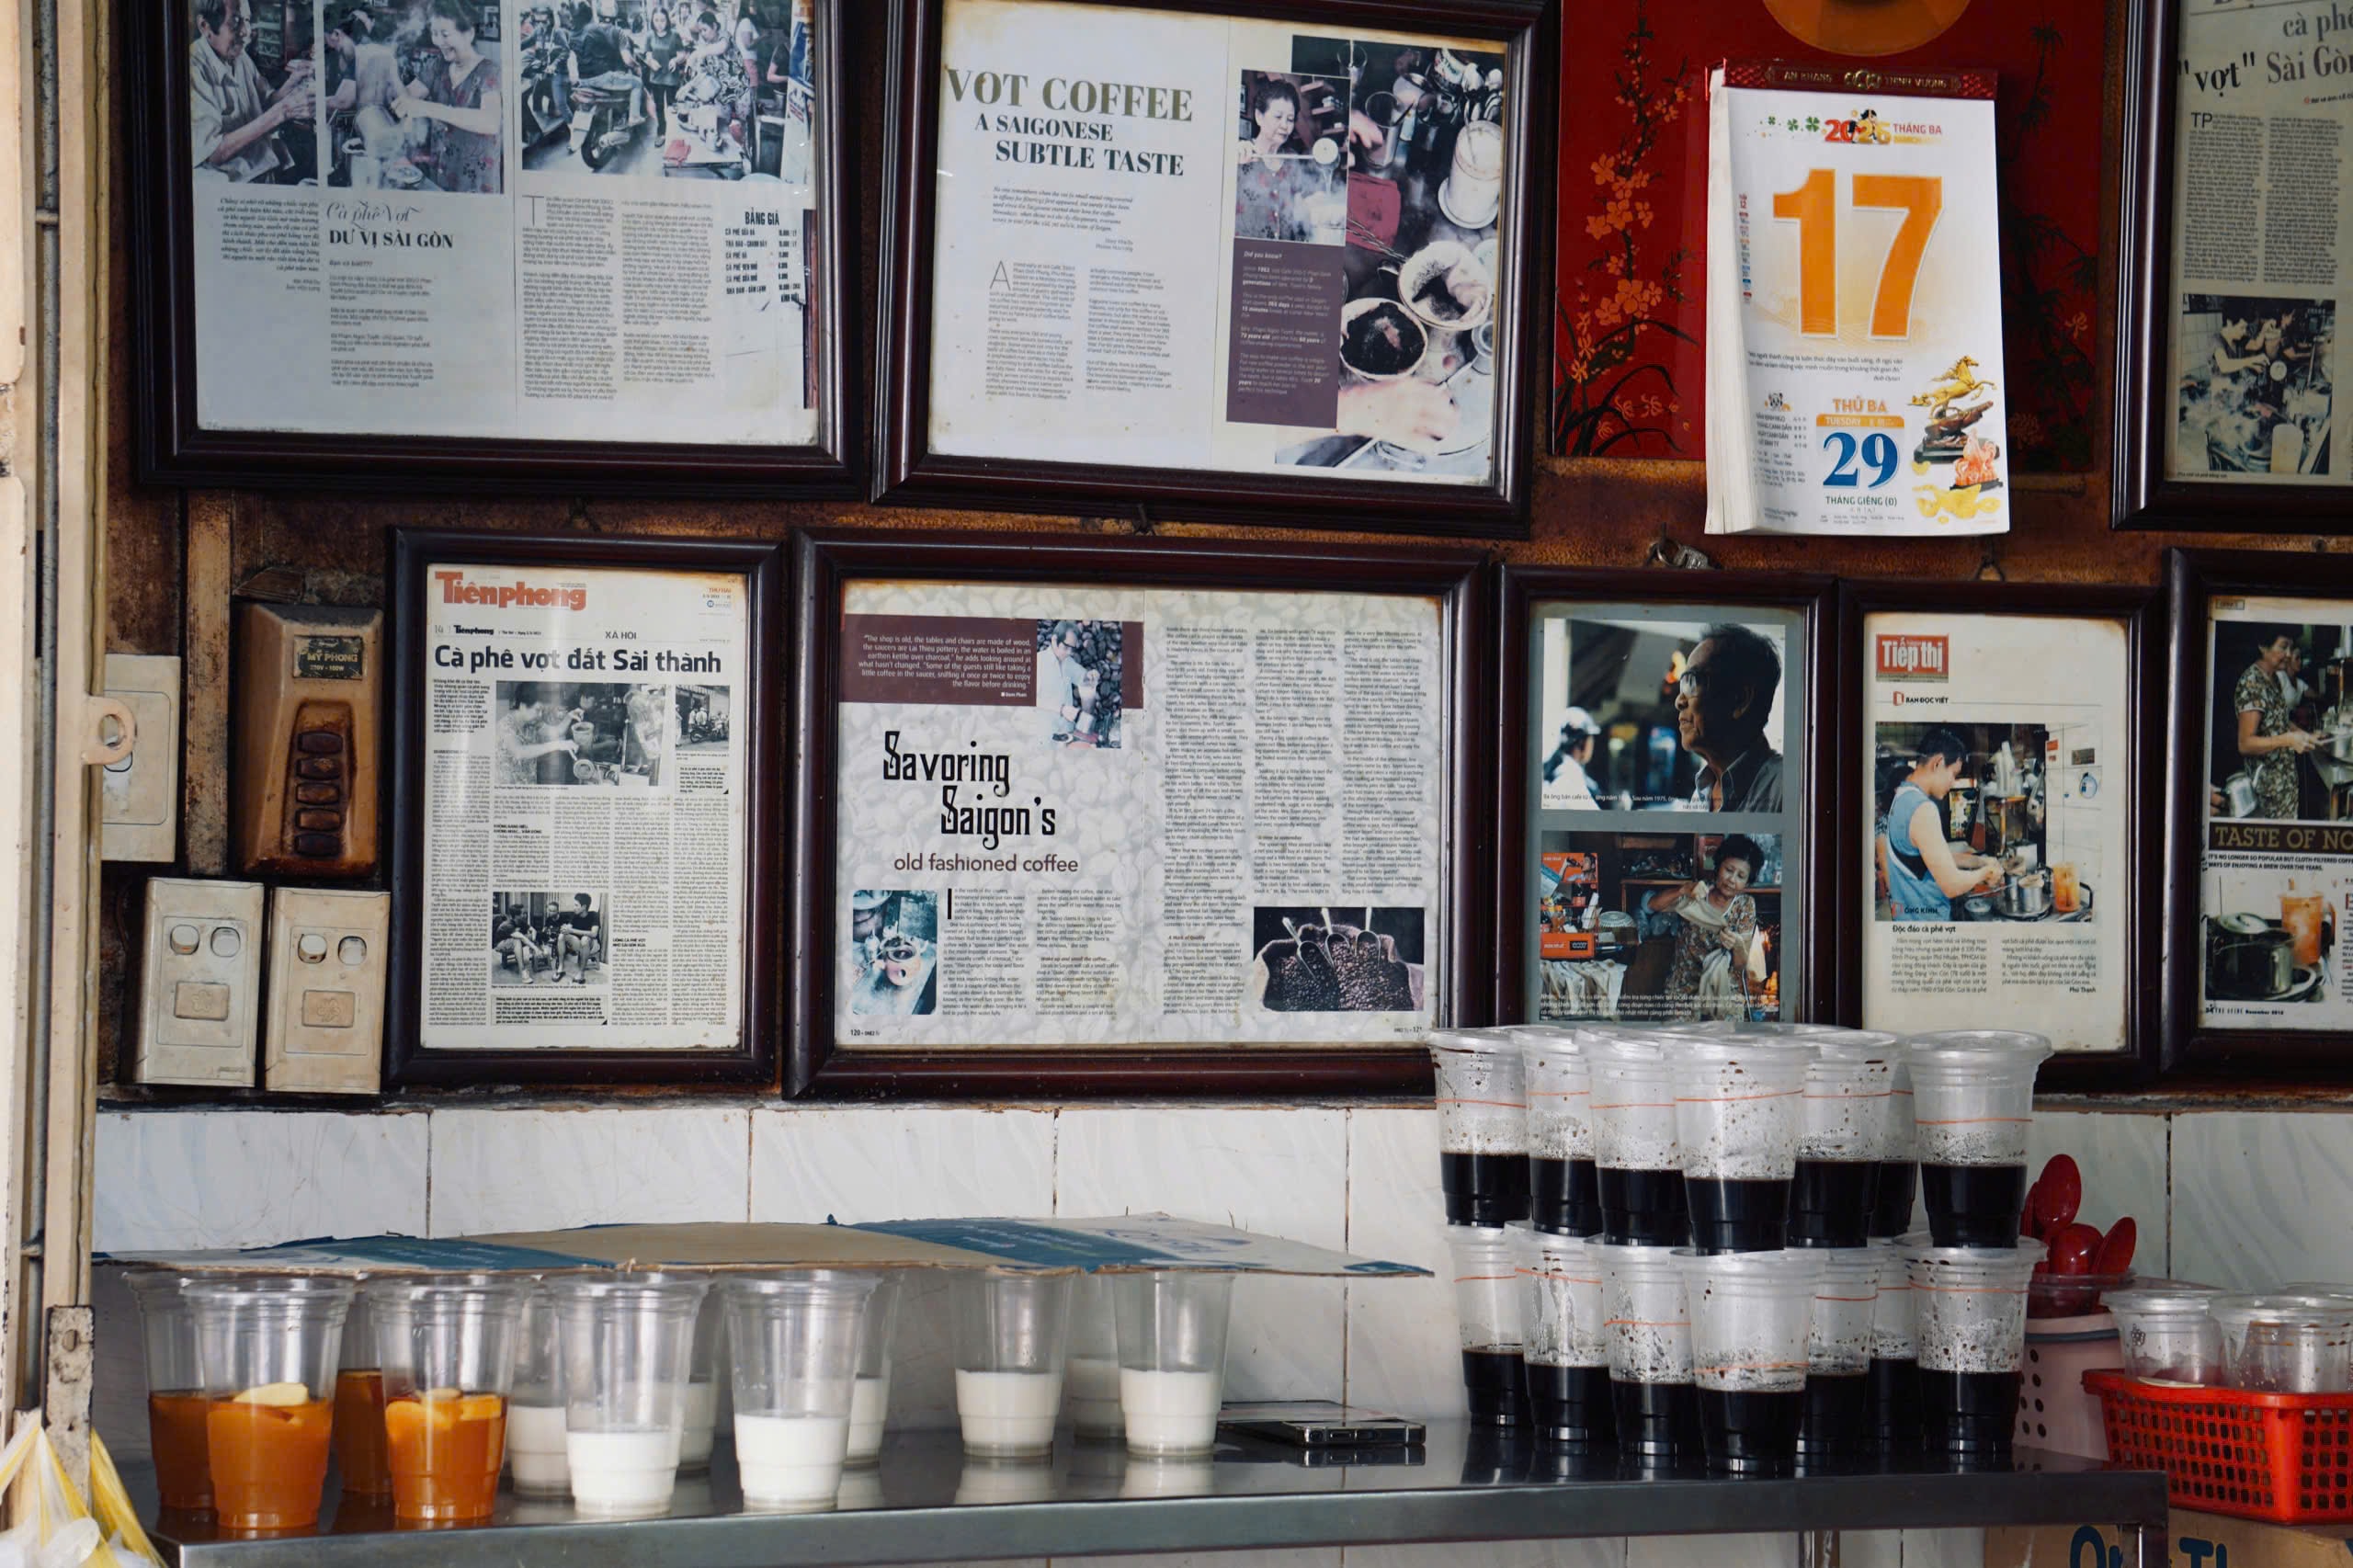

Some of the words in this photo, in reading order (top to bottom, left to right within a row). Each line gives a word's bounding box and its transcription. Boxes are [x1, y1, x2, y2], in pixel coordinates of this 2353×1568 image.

[2283, 13, 2308, 37] cà
[2267, 51, 2305, 84] Sài
[948, 68, 1029, 108] VOT
[1041, 77, 1192, 121] COFFEE
[974, 113, 989, 131] A
[996, 115, 1113, 142] SAIGONESE
[1893, 122, 1927, 133] THÁNG
[1928, 124, 1942, 134] BA
[995, 140, 1095, 169] SUBTLE
[1104, 149, 1184, 176] TASTE
[745, 207, 765, 224] BẢNG
[767, 210, 779, 225] GIÁ
[329, 229, 356, 244] DƯ
[360, 231, 377, 248] VỊ
[383, 230, 411, 247] SÀI
[416, 231, 453, 248] GÒN
[1773, 168, 1943, 339] 17
[1833, 395, 1864, 412] THỨ
[1868, 400, 1887, 412] BA
[1824, 432, 1898, 488] 29
[1825, 494, 1855, 505] THÁNG
[1858, 495, 1882, 506] GIÊNG
[1885, 496, 1897, 506] (Đ)
[880, 635, 892, 643] shop
[902, 635, 912, 643] old,
[435, 645, 463, 667] Cà
[471, 645, 514, 674] phê
[567, 647, 606, 670] đất
[613, 649, 648, 671] Sài
[655, 650, 721, 673] thành
[981, 654, 1002, 664] looking
[1882, 637, 1918, 672] Tiếp
[1921, 641, 1942, 672] thị
[938, 671, 959, 679] sniffing
[1007, 664, 1026, 673] taking
[883, 731, 1010, 798] Savoring
[941, 785, 1055, 850] Saigon's
[2215, 826, 2279, 847] TASTE
[2287, 829, 2316, 849] OF
[894, 853, 923, 871] old
[928, 853, 1017, 872] fashioned
[1022, 854, 1078, 872] coffee
[1893, 925, 1905, 934] Độc
[1907, 925, 1920, 933] đáo
[1930, 926, 1943, 934] phê
